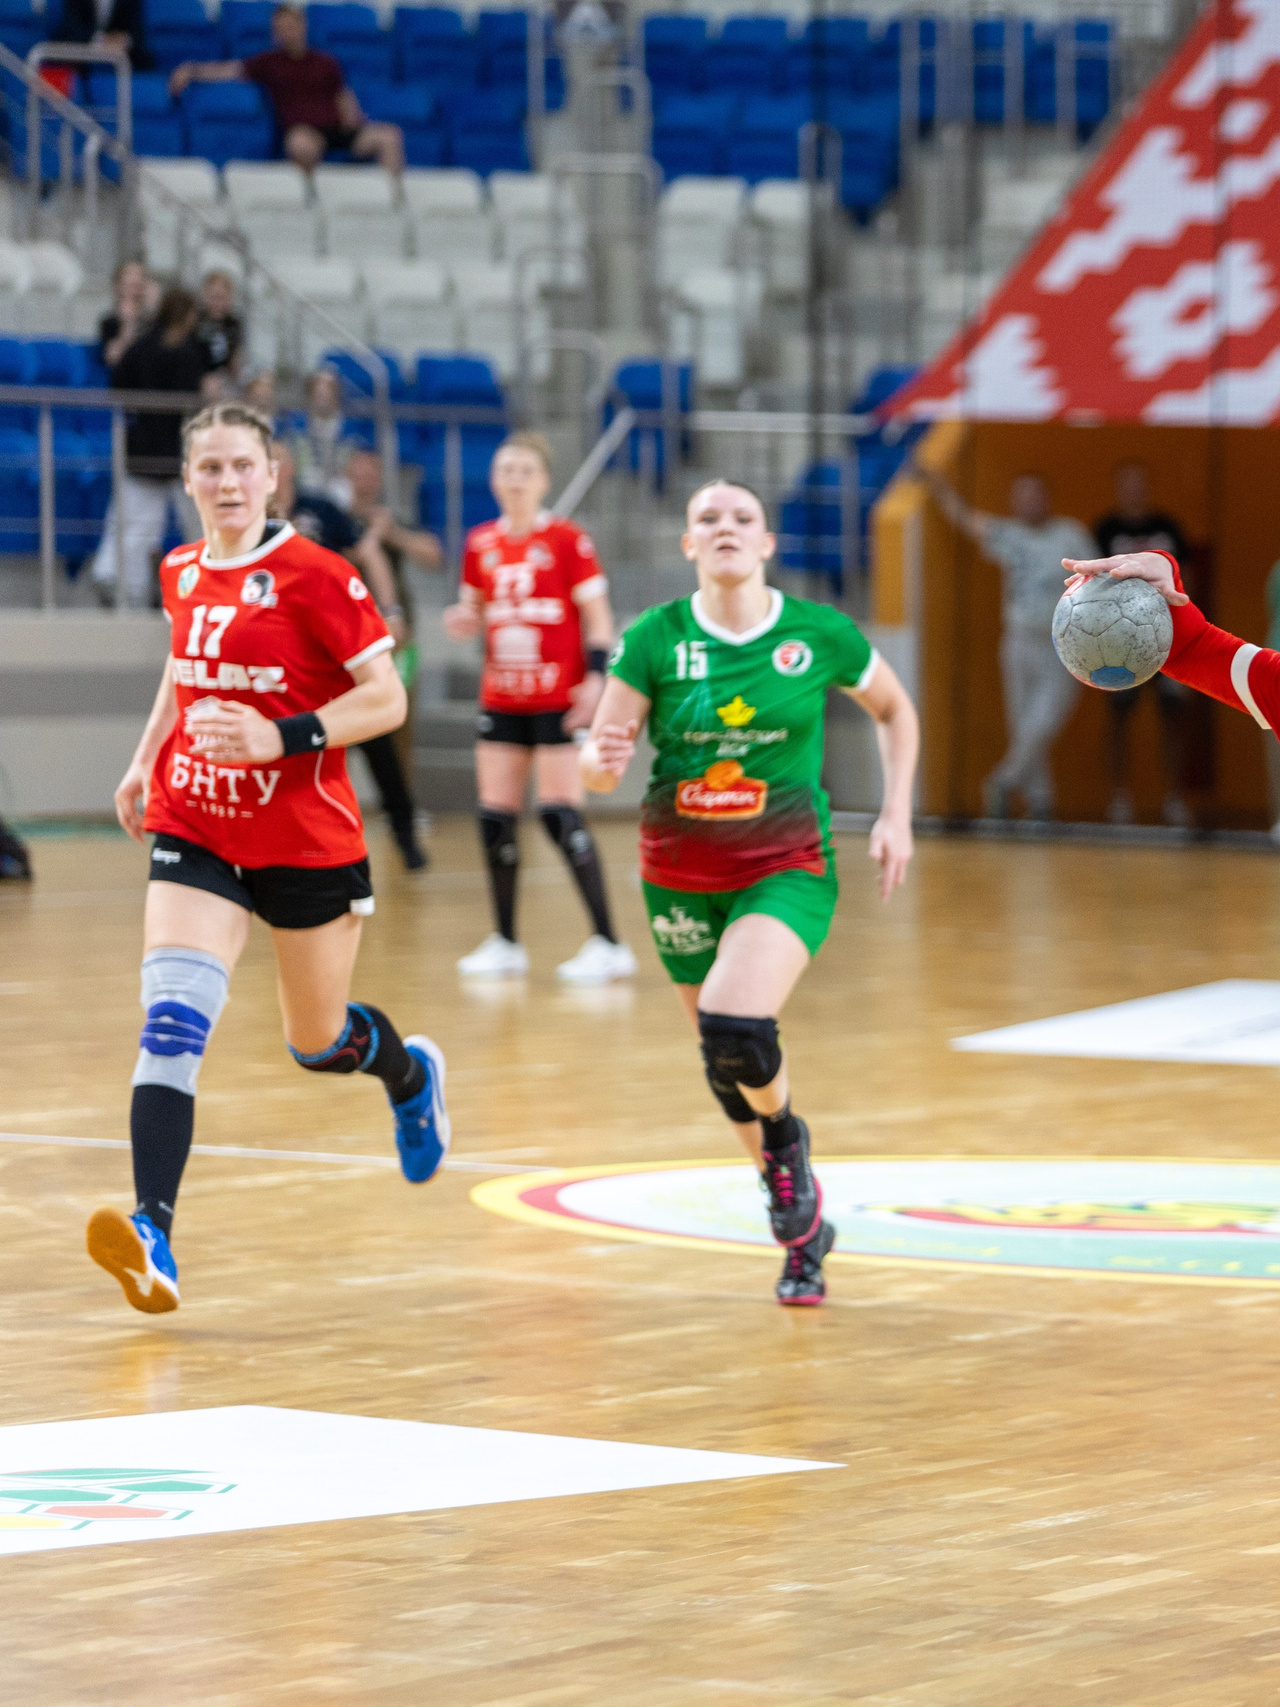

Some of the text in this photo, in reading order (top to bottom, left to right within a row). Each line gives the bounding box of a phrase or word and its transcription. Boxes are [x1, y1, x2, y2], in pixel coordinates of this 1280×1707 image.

[185, 604, 238, 659] 17
[173, 659, 289, 694] ELAZ
[674, 639, 709, 681] 15
[171, 752, 282, 806] БНТУ
